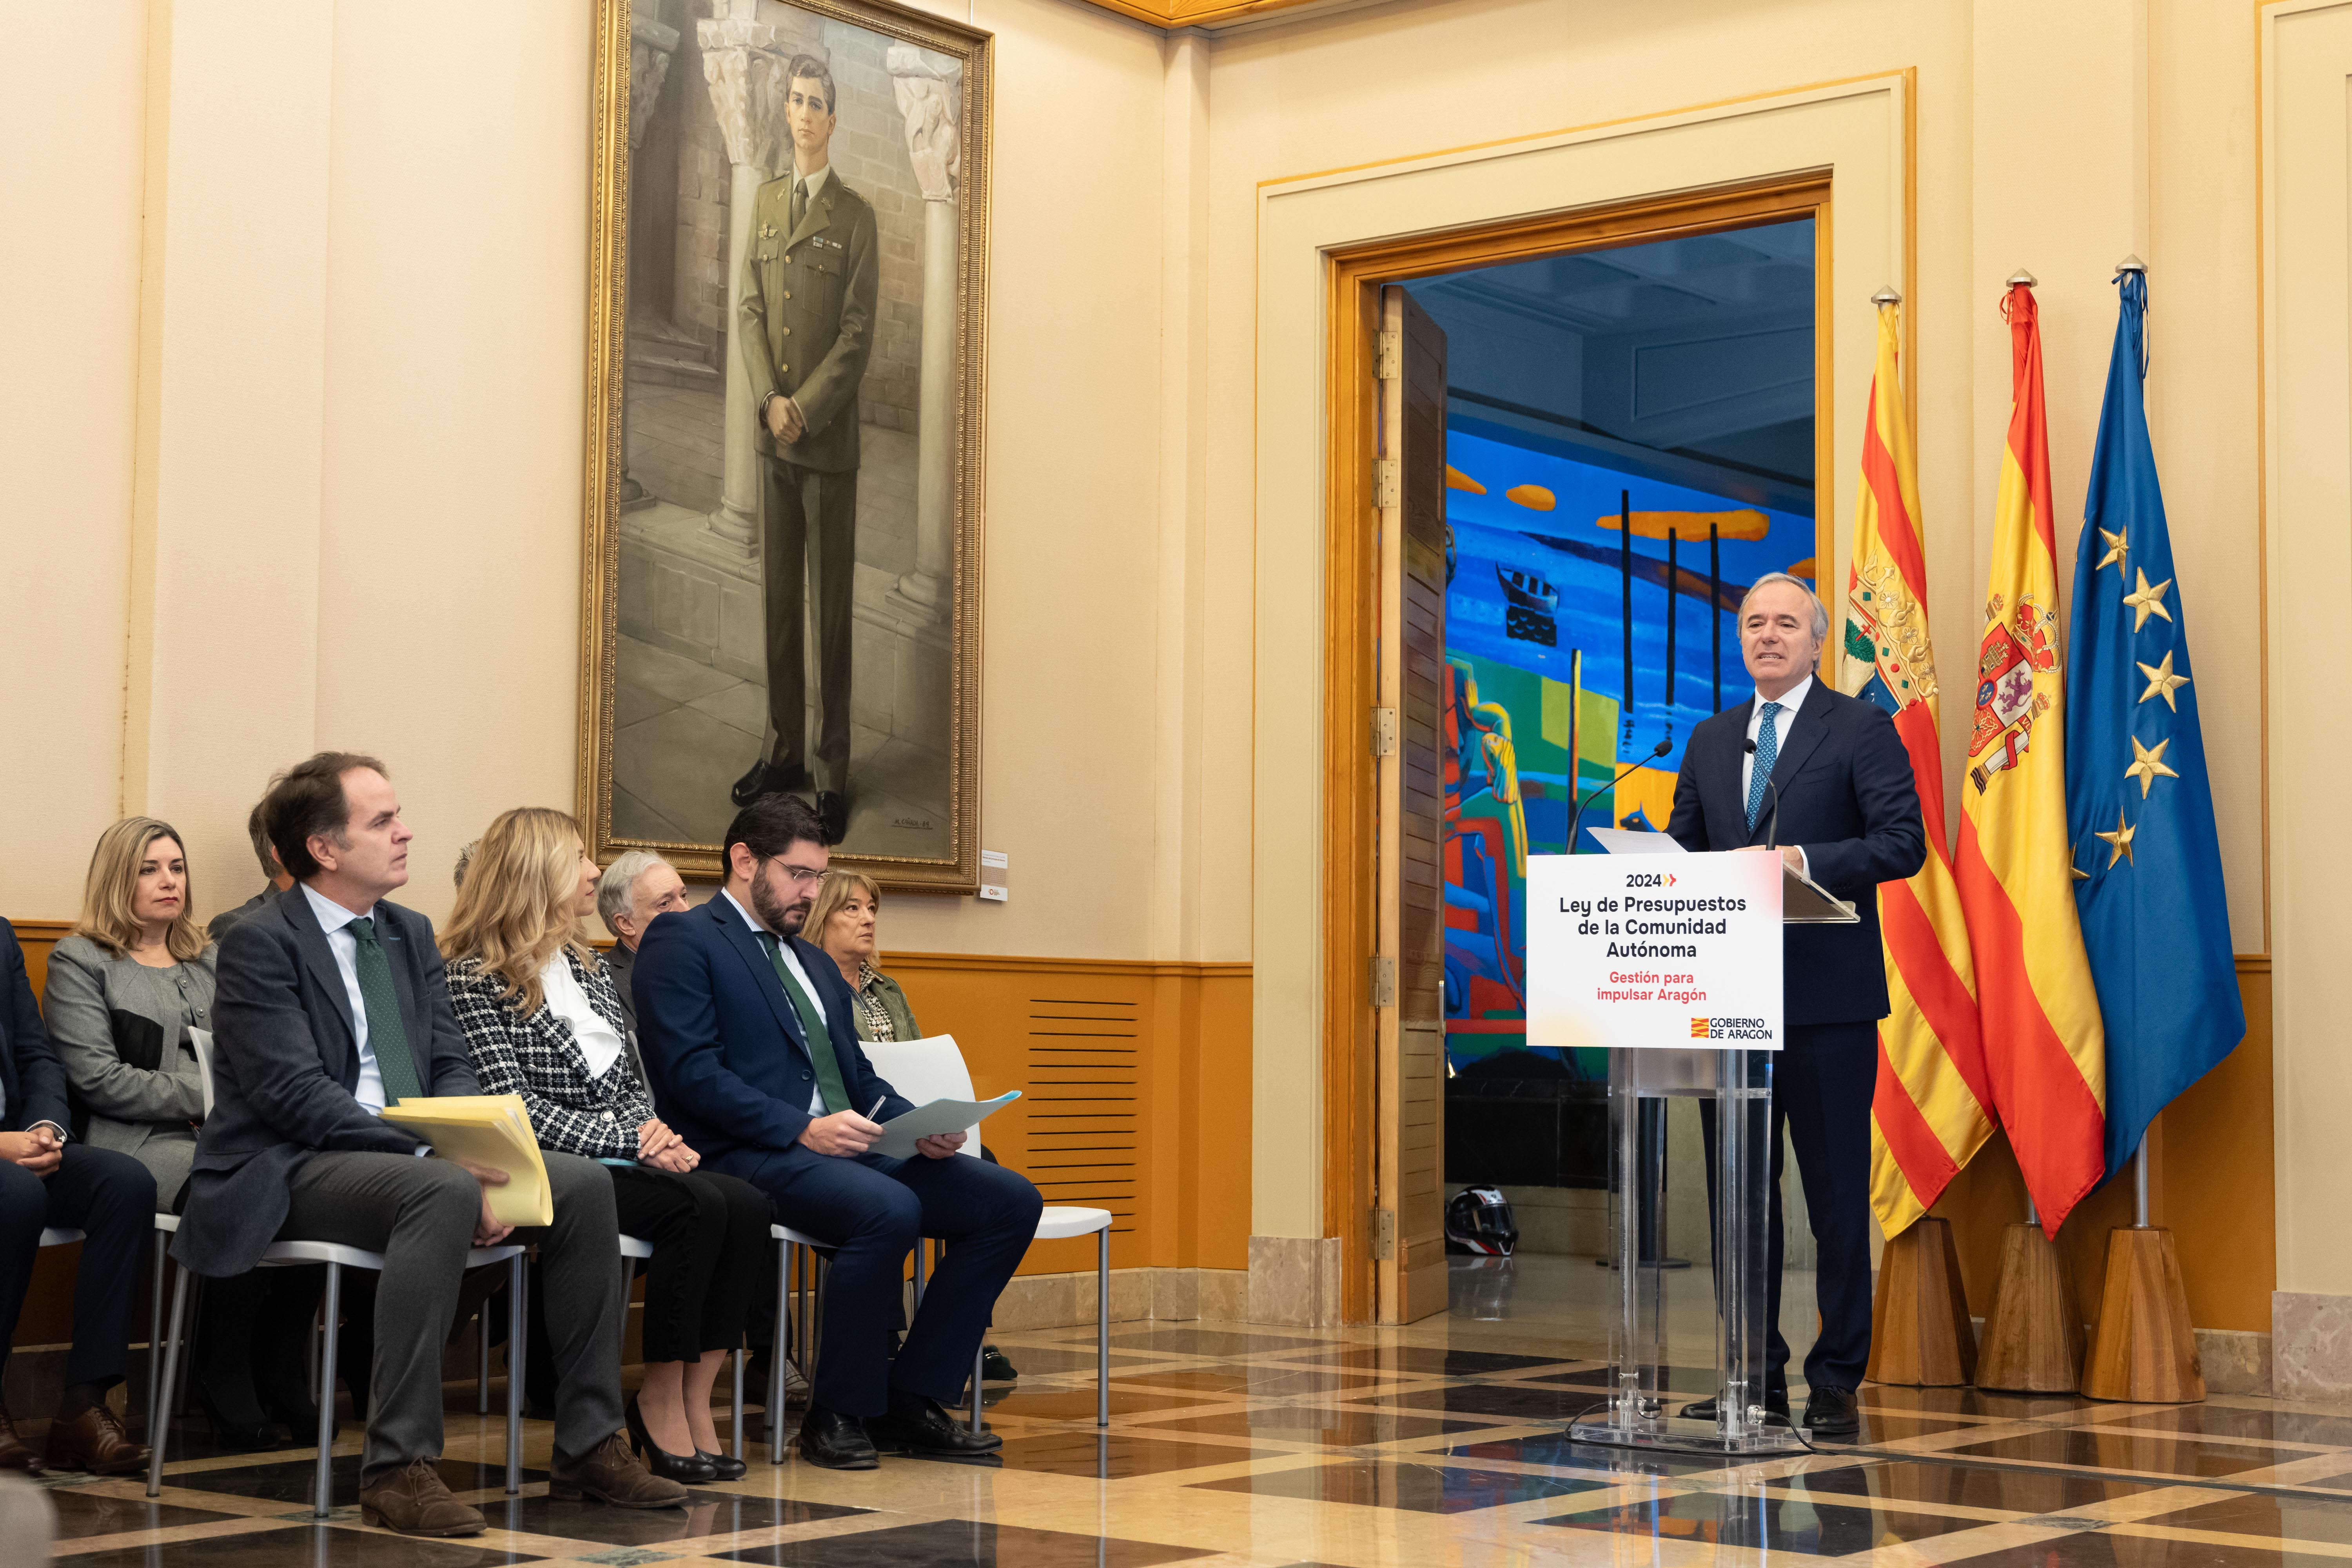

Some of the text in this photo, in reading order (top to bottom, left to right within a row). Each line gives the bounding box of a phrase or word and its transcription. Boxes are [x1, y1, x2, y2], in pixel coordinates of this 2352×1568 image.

[1626, 874, 1662, 887] 2024
[1560, 896, 1746, 917] Ley de Presupuestos
[1578, 918, 1726, 935] de la Comunidad
[1606, 940, 1697, 957] Autónoma
[1610, 971, 1694, 986] Gestión para
[1597, 987, 1706, 1004] impulsar Aragón
[1710, 1018, 1764, 1028] GOBIERNO
[1710, 1029, 1772, 1040] DE ARAGON
